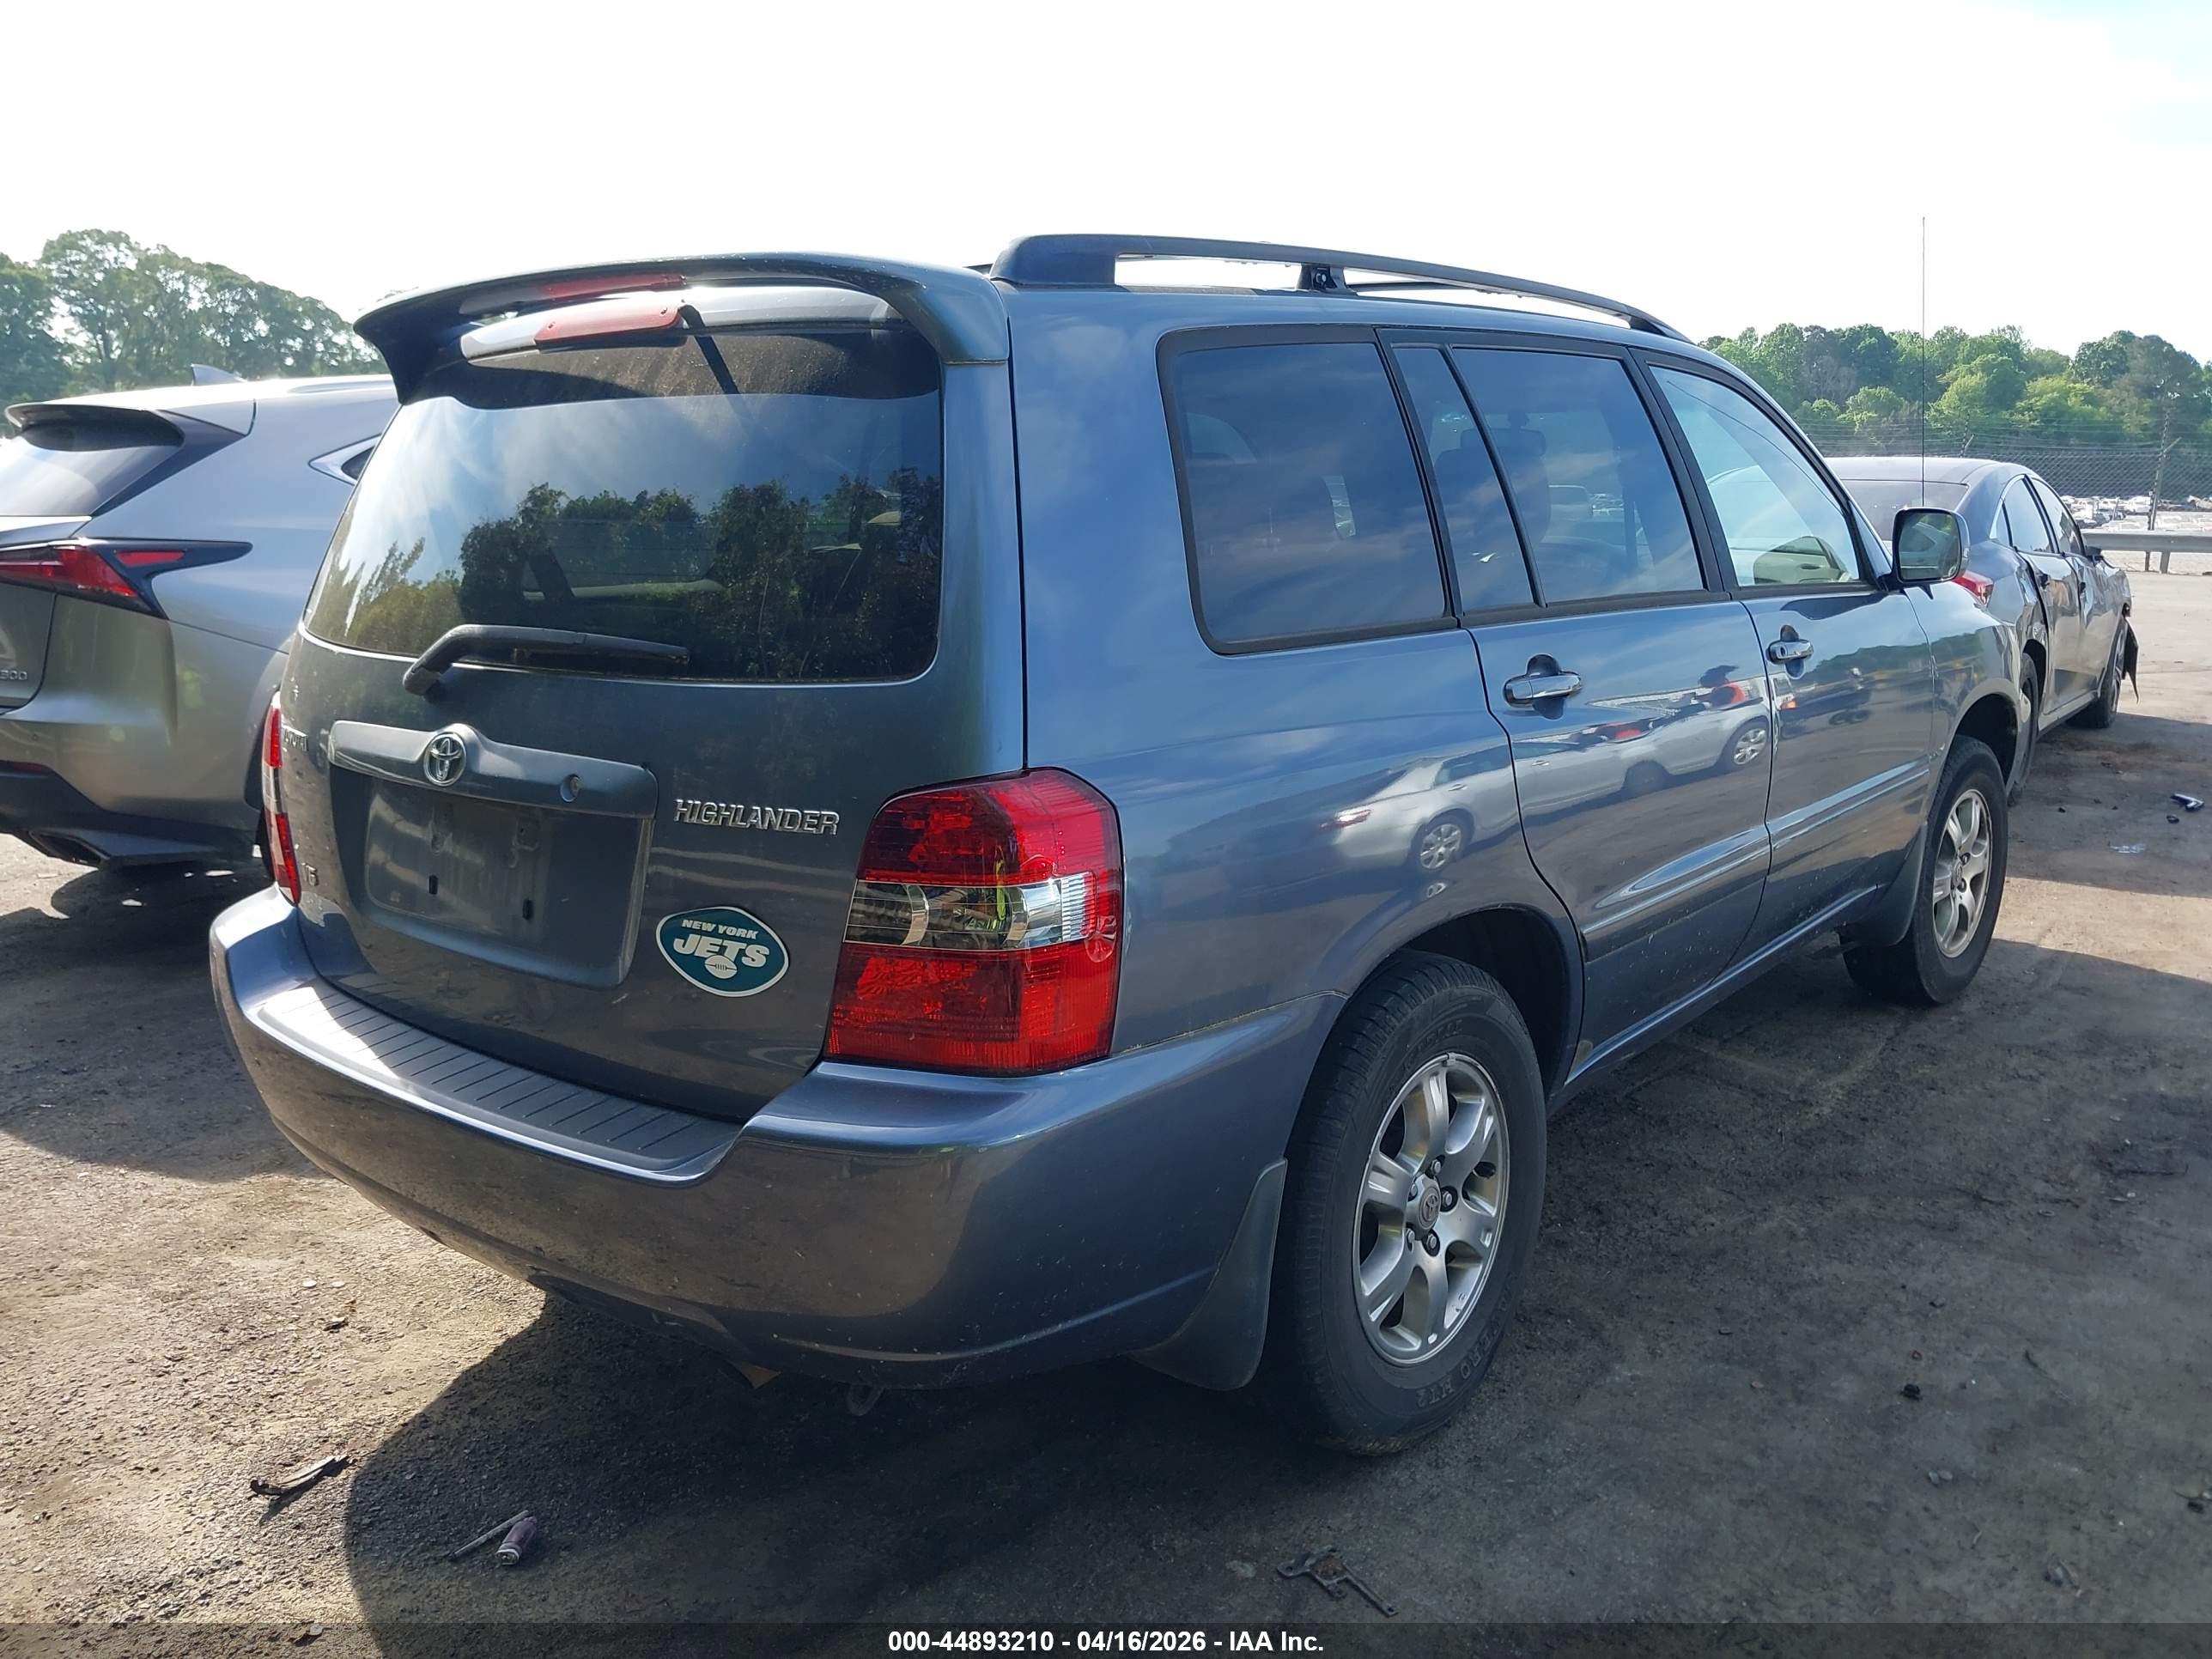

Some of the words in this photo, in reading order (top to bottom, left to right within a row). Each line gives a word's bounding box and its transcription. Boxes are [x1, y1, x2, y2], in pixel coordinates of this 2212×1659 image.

[673, 799, 840, 836] HIGHLANDER
[681, 919, 716, 933] NEW
[717, 924, 759, 940] YORK
[672, 933, 770, 968] JETS
